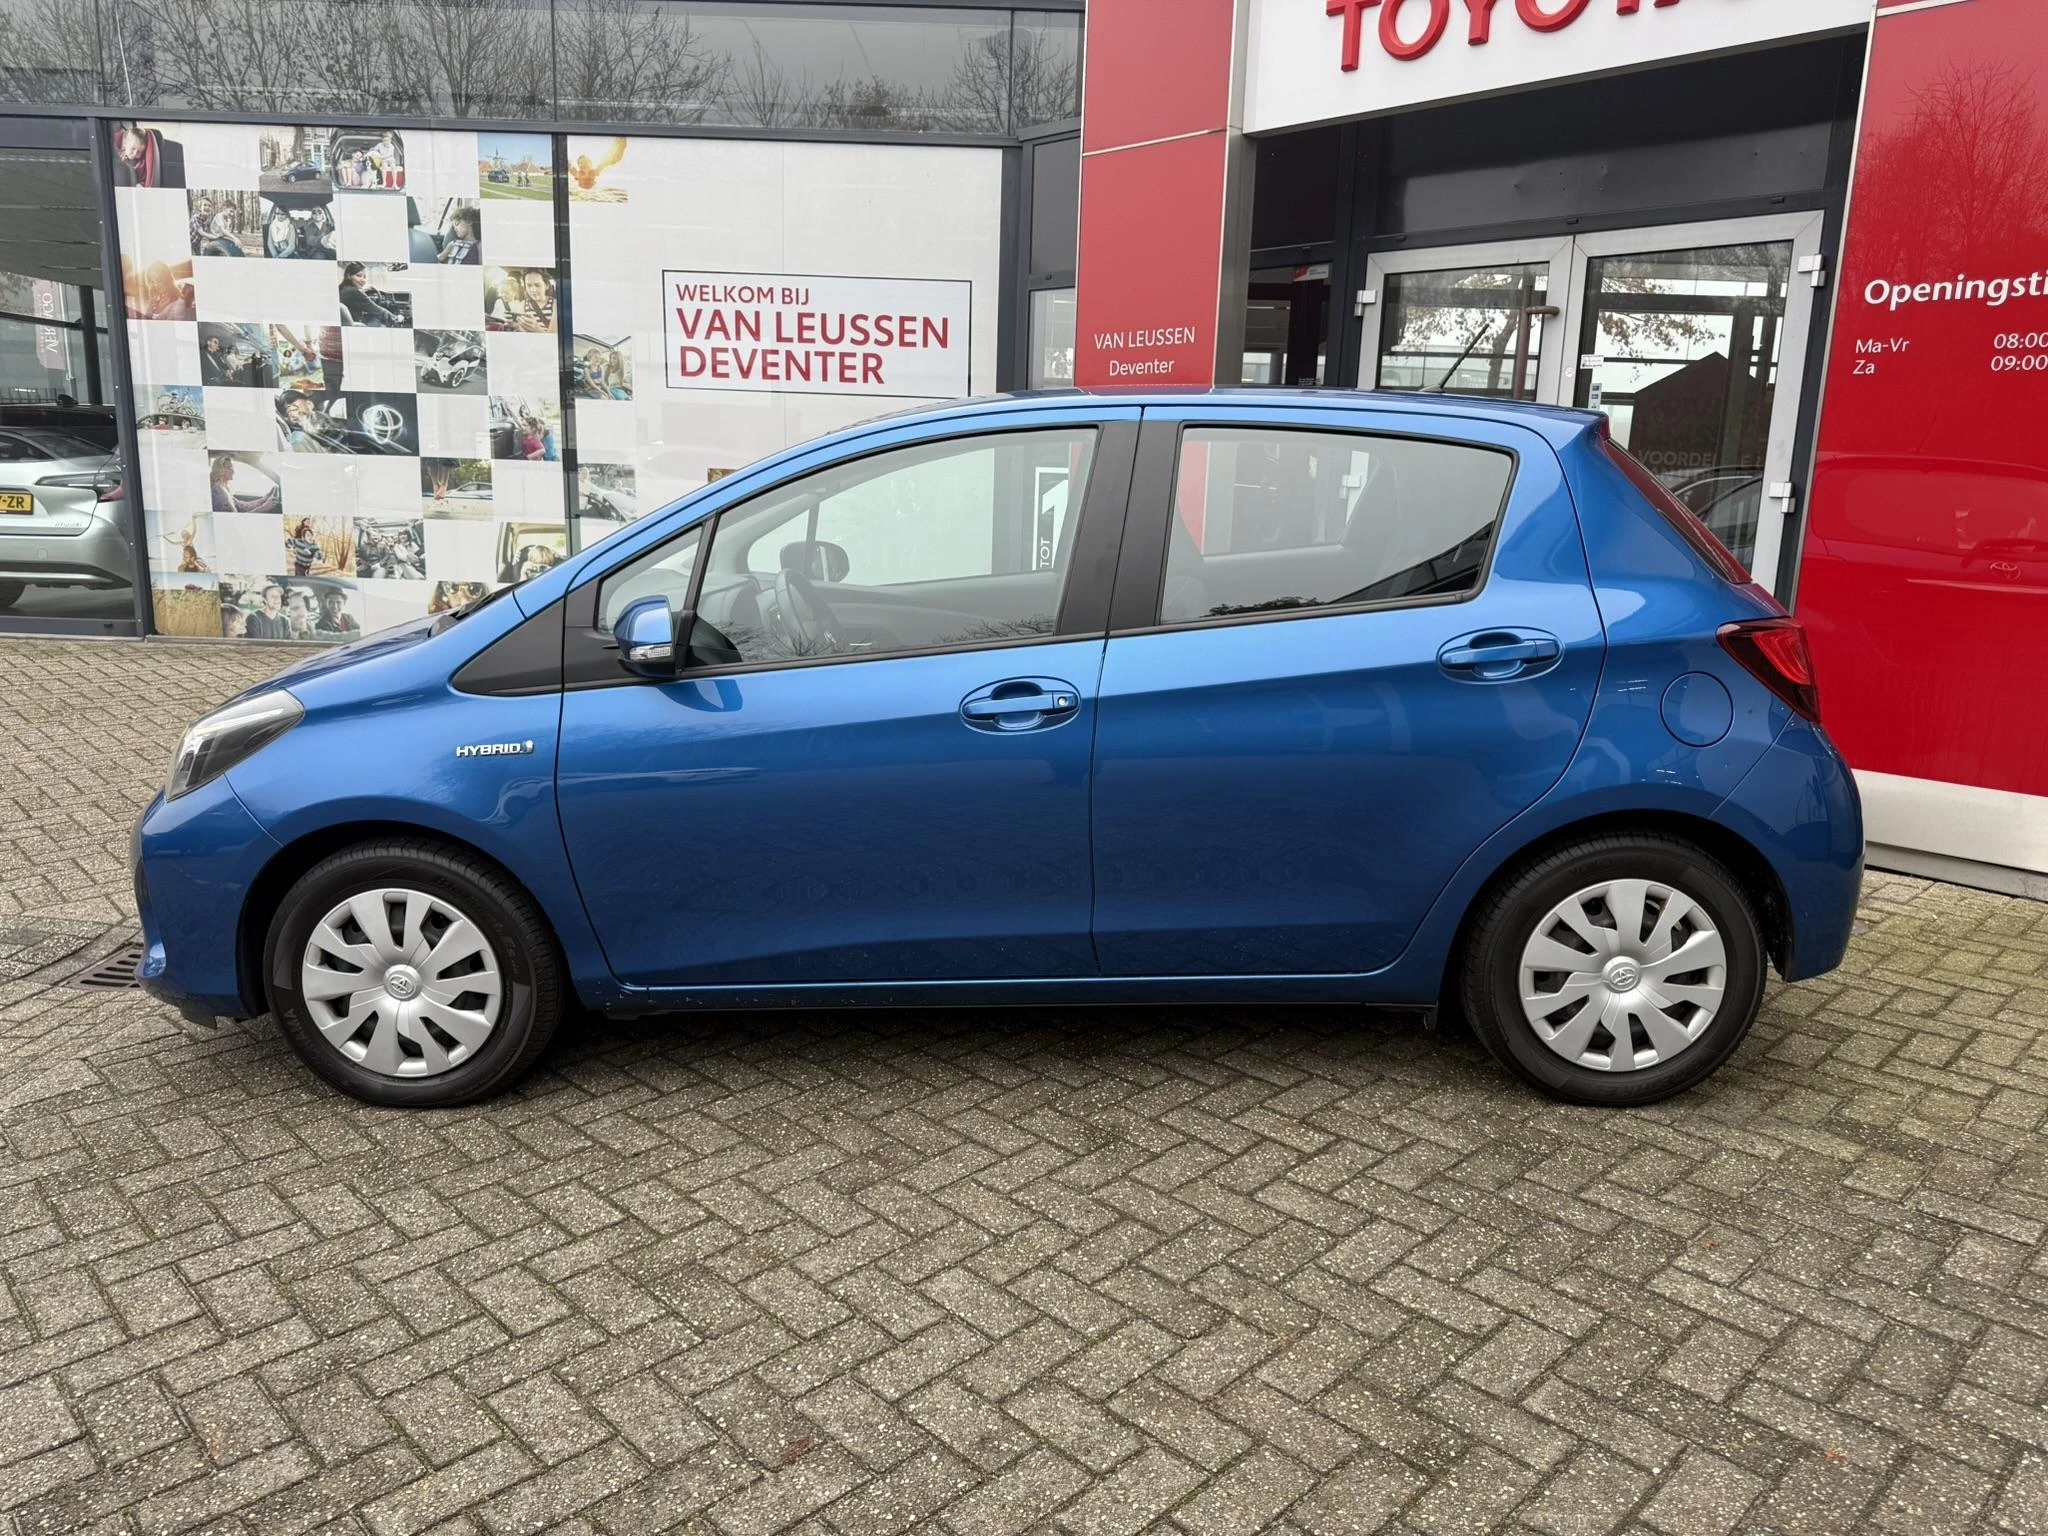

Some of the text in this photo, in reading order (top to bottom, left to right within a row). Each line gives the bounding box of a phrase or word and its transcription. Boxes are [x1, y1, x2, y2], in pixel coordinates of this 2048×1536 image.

[675, 283, 810, 306] WELKOM BIJ
[676, 307, 949, 349] VAN LEUSSEN
[1094, 326, 1196, 350] VAN LEUSSEN
[1855, 332, 2048, 354] Ma-Vr 08:00
[679, 345, 886, 385] DEVENTER
[1109, 358, 1175, 376] Deventer
[1852, 354, 2048, 375] Za 09:00
[456, 743, 521, 757] HYBRID
